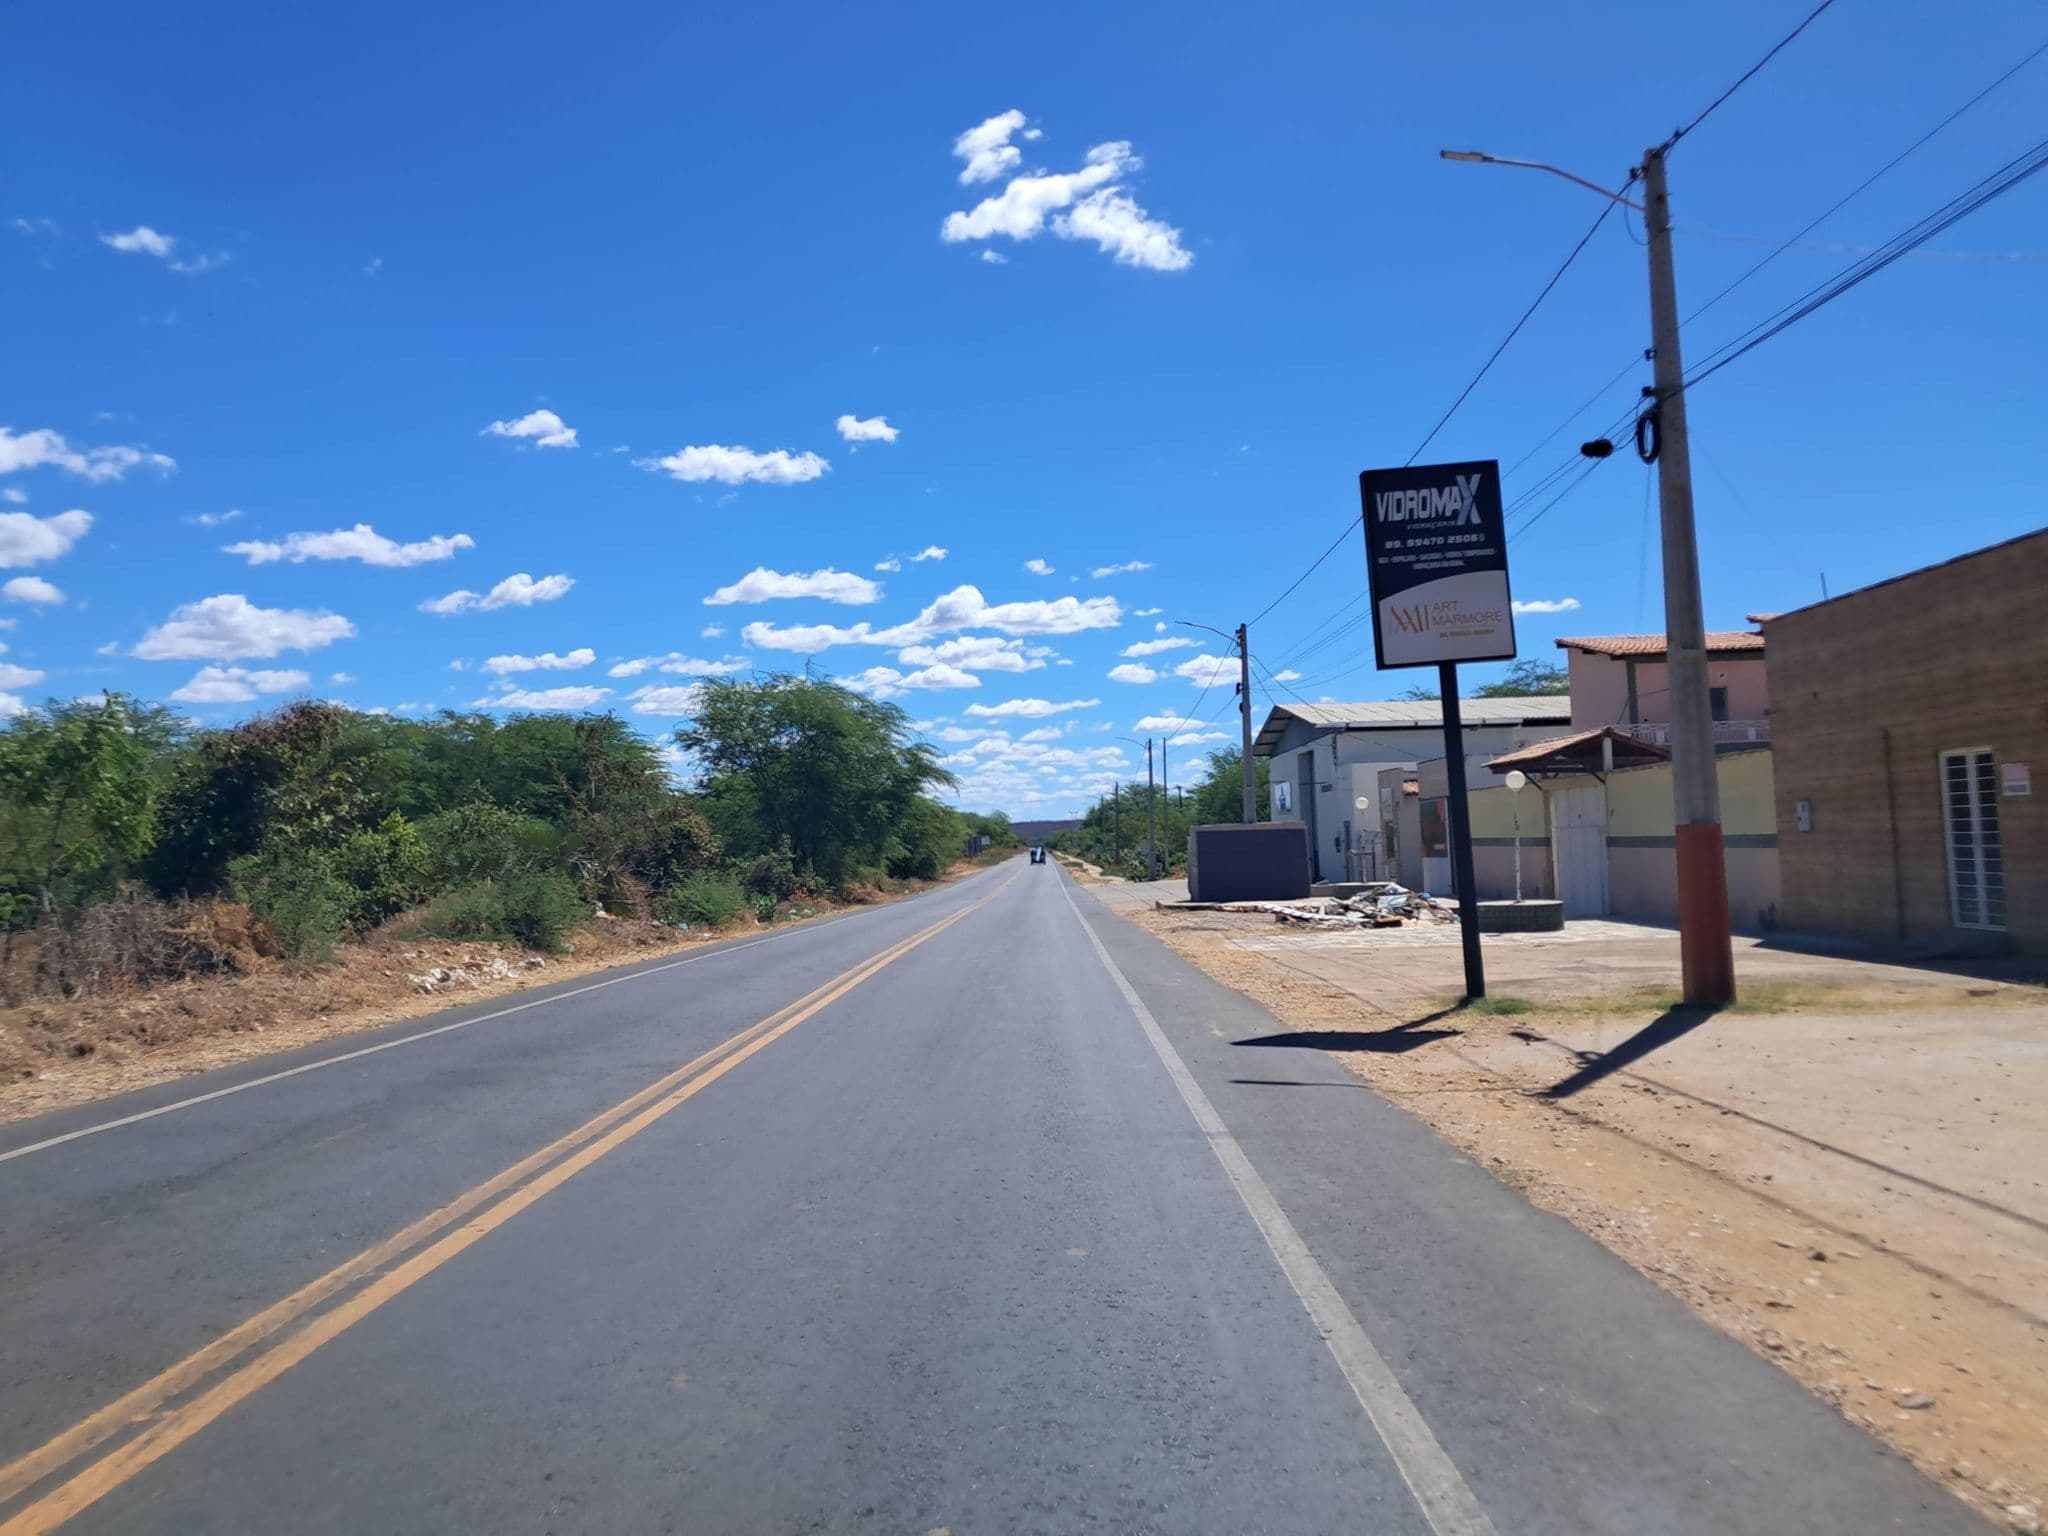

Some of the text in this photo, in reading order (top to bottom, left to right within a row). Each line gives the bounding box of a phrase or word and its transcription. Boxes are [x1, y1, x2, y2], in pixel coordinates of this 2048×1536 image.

[1375, 474, 1481, 524] VIDROMAX
[1433, 600, 1458, 610] ART
[1433, 610, 1503, 625] MARMORE
